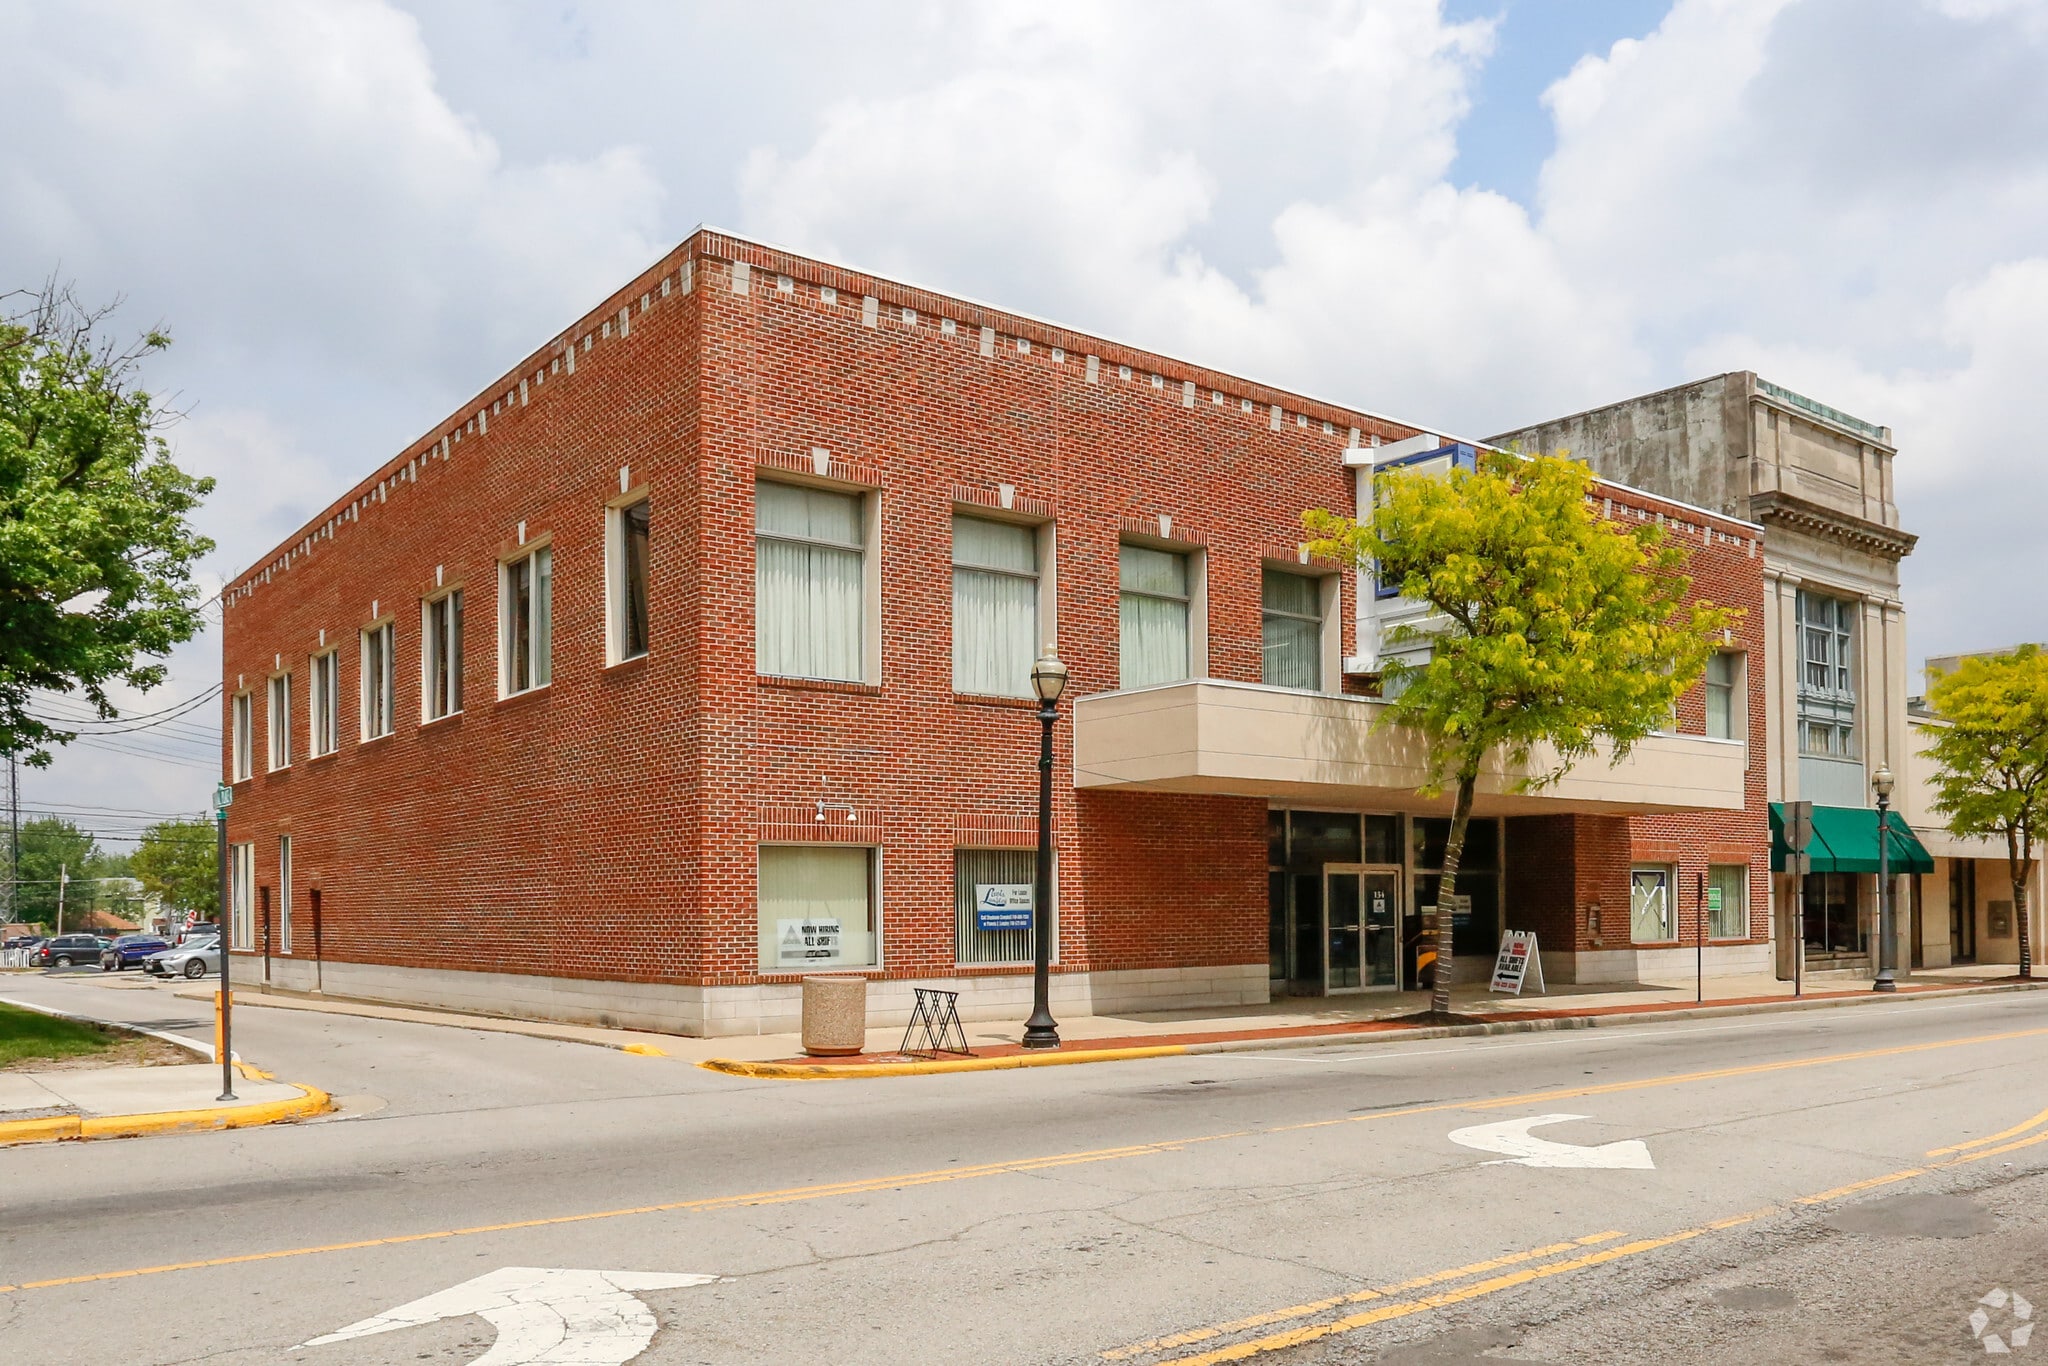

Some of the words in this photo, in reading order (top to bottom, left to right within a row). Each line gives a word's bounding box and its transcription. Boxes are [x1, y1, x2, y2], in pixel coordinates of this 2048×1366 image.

[801, 925, 817, 934] NOW
[818, 925, 840, 934] HIRING
[804, 936, 815, 946] ALL
[1498, 963, 1522, 972] AVAILABLE
